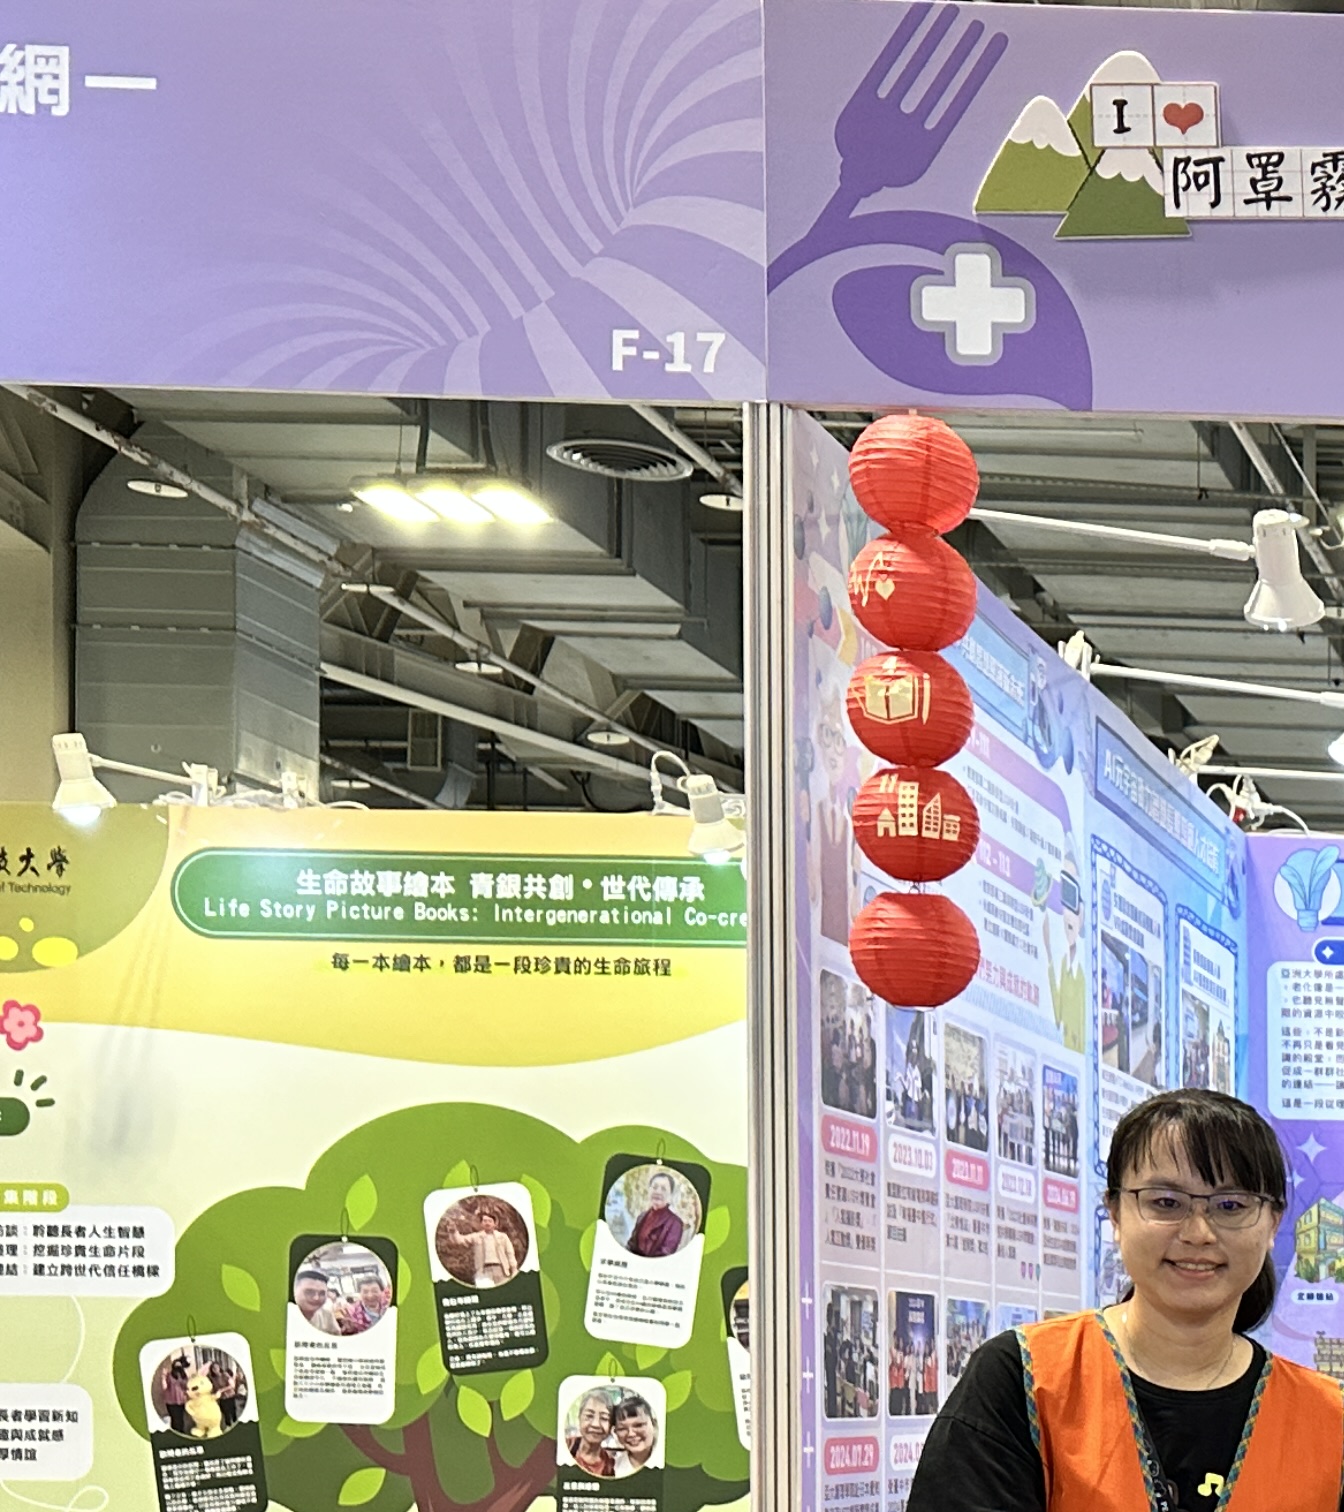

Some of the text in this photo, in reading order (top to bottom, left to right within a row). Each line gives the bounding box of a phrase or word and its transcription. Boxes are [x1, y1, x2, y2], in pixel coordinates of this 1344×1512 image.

[1112, 98, 1129, 133] I
[611, 328, 726, 374] F-17
[9, 882, 71, 896] Technology
[296, 870, 456, 899] 生命故事繪本
[204, 899, 250, 919] Life
[260, 900, 316, 925] Story
[326, 900, 404, 922] Picture
[414, 902, 479, 923] Books:
[494, 904, 672, 928] Intergenerational
[331, 952, 672, 977] 每一本繪本，都是一段珍貴的生命旅程
